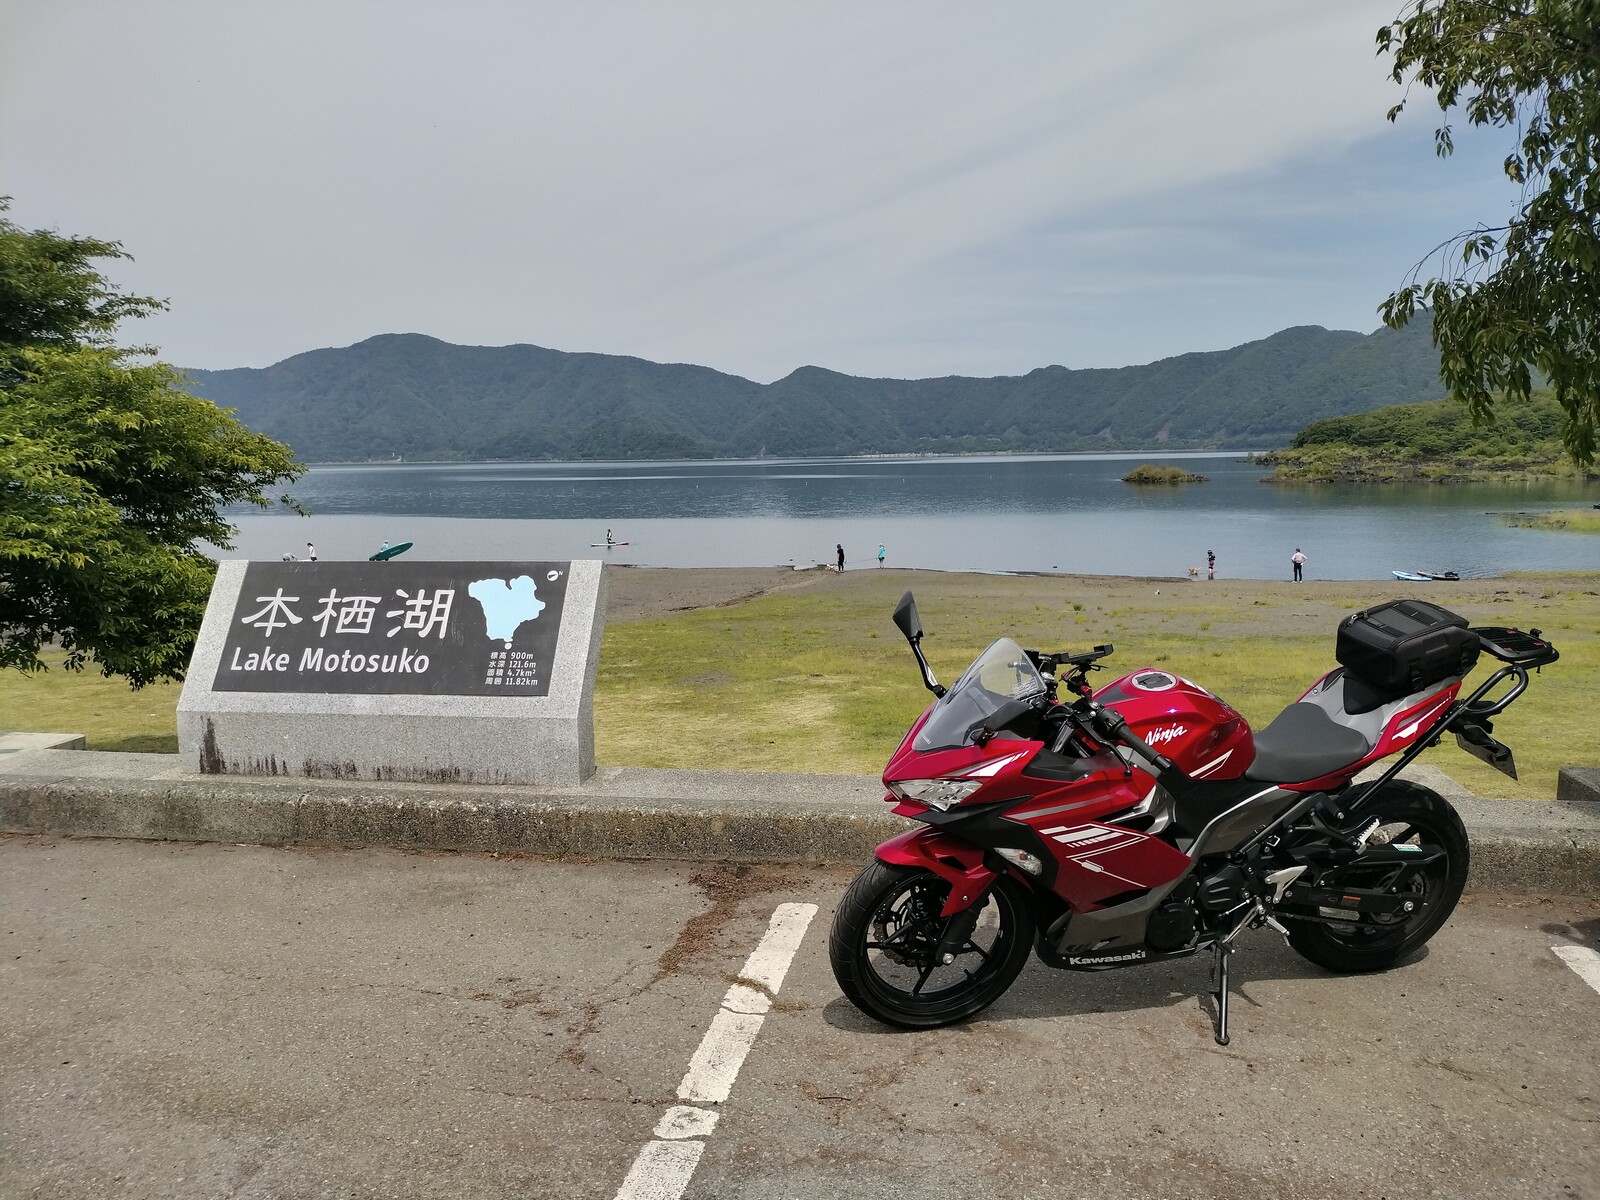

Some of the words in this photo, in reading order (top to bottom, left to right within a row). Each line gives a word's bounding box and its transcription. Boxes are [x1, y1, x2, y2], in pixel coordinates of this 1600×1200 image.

[241, 588, 456, 639] 本栖湖
[230, 646, 290, 672] Lake
[298, 647, 430, 674] Motosuko
[490, 651, 507, 660] 標高
[510, 651, 534, 660] 900m
[488, 660, 506, 668] 水深
[508, 660, 537, 668] 121.6m
[486, 668, 504, 677] 面積
[505, 677, 538, 685] 11.82km
[1144, 722, 1188, 746] Ninja
[1069, 950, 1147, 965] Kawasaki
